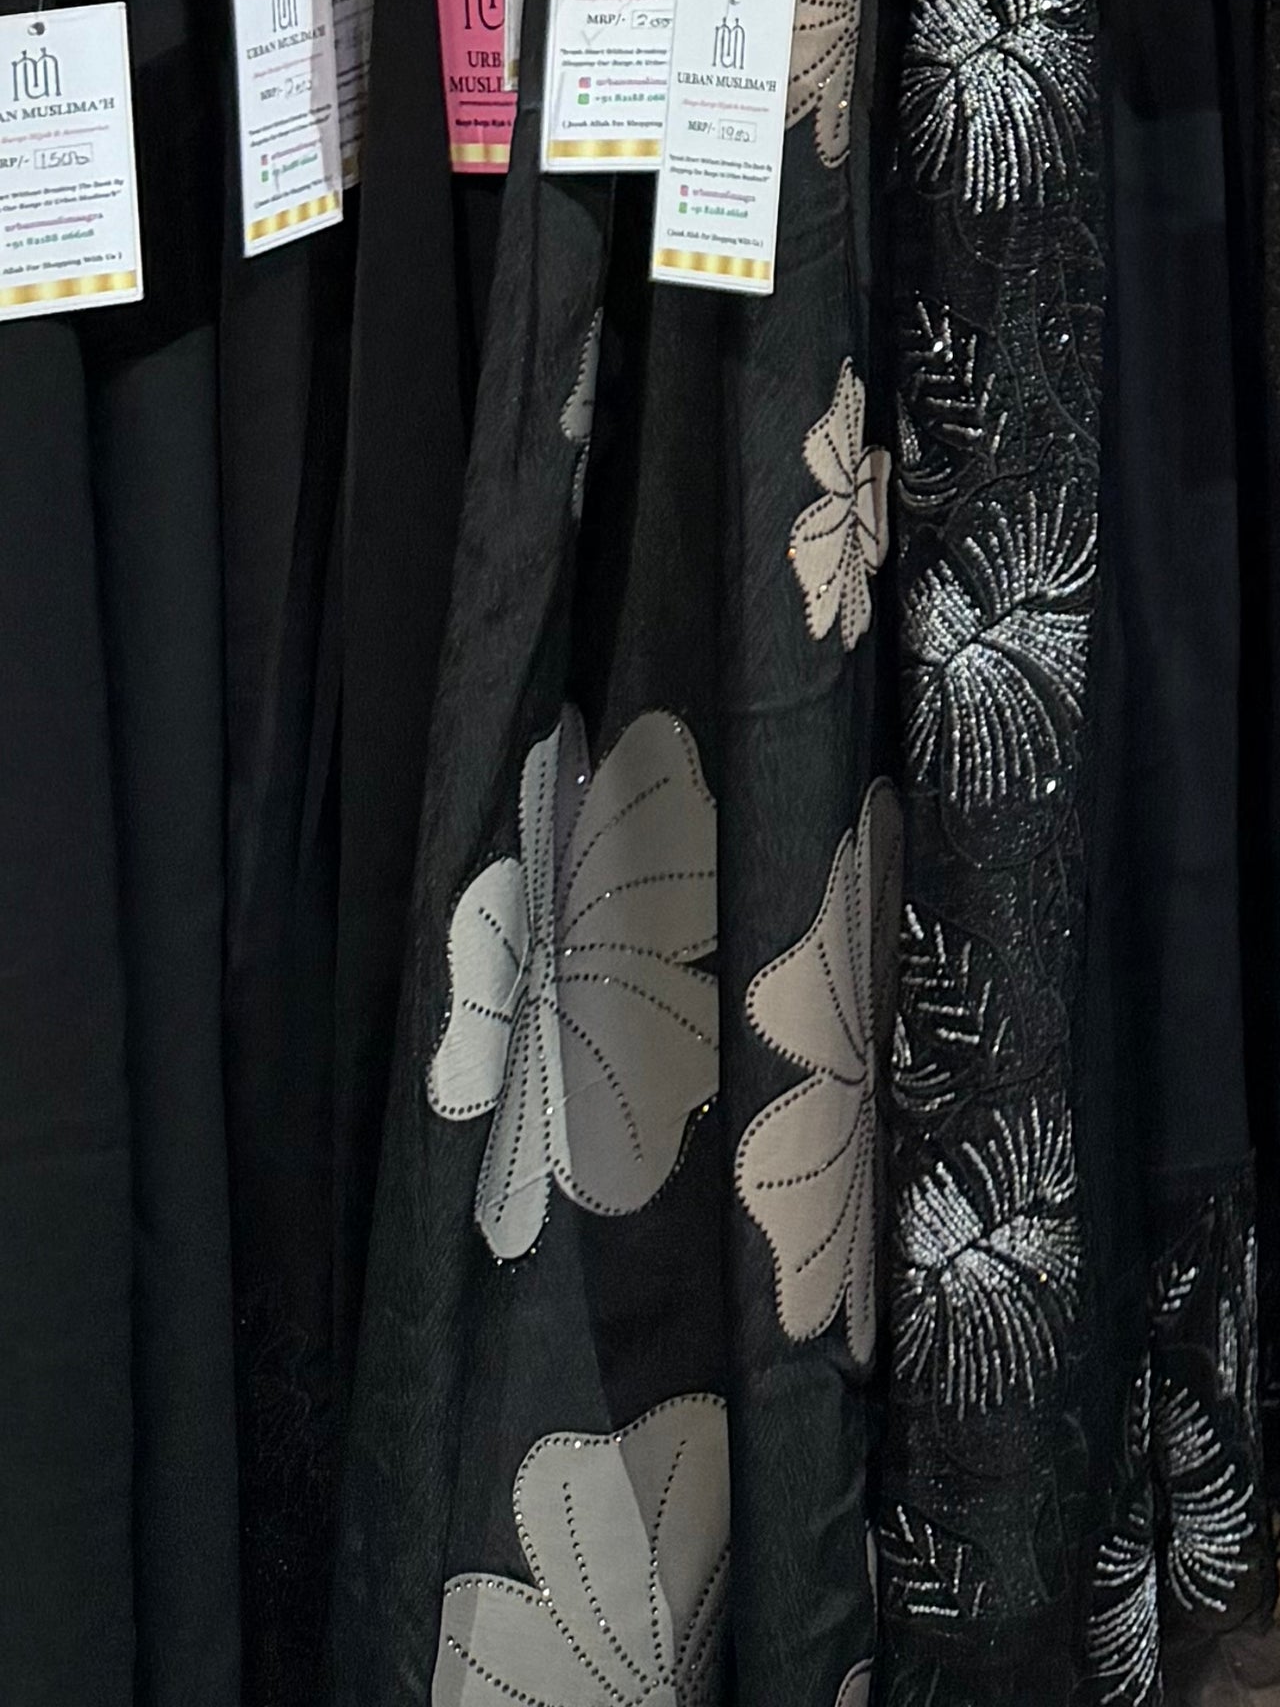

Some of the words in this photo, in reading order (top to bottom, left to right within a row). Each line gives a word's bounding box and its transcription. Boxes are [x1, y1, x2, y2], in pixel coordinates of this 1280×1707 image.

[466, 51, 503, 68] URB
[449, 75, 505, 93] MUSLI
[677, 71, 714, 86] URBAN
[715, 75, 778, 93] MUSLIMA'H
[22, 97, 115, 120] MUSLIMA'H
